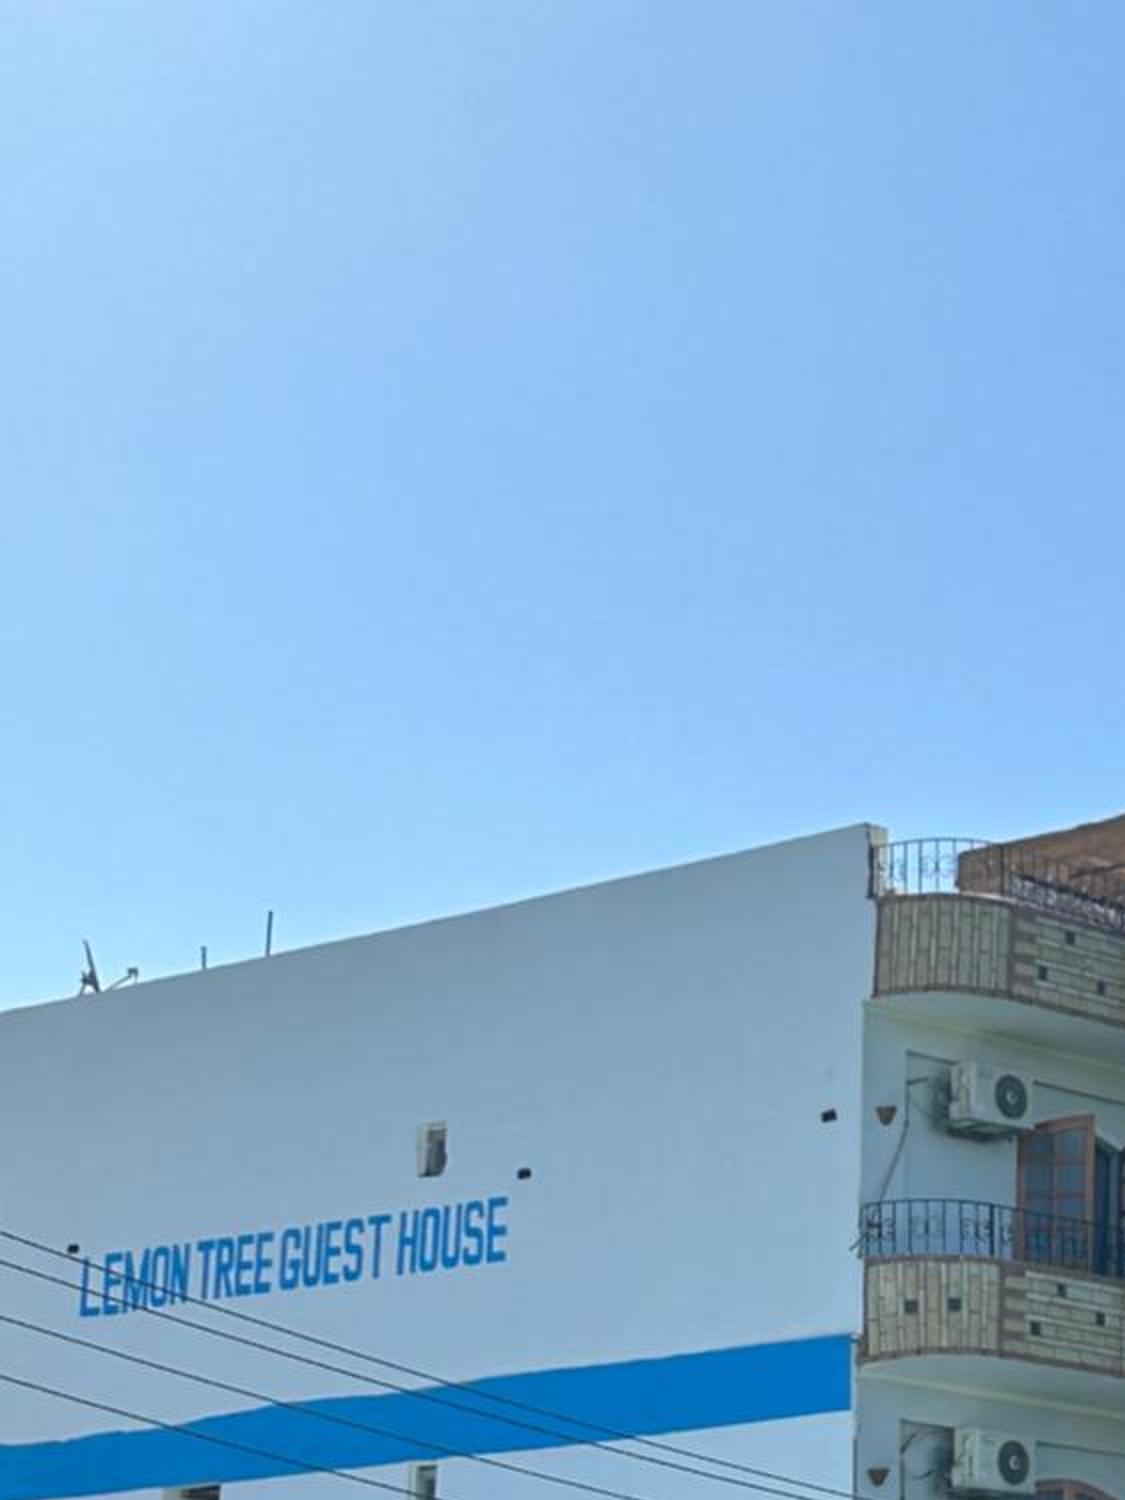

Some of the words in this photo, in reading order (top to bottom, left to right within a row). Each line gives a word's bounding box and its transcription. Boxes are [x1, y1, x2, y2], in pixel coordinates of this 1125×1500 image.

[79, 1242, 192, 1318] LEMON
[197, 1231, 274, 1300] TREE
[278, 1213, 392, 1292] GUEST
[396, 1197, 509, 1276] HOUSE
